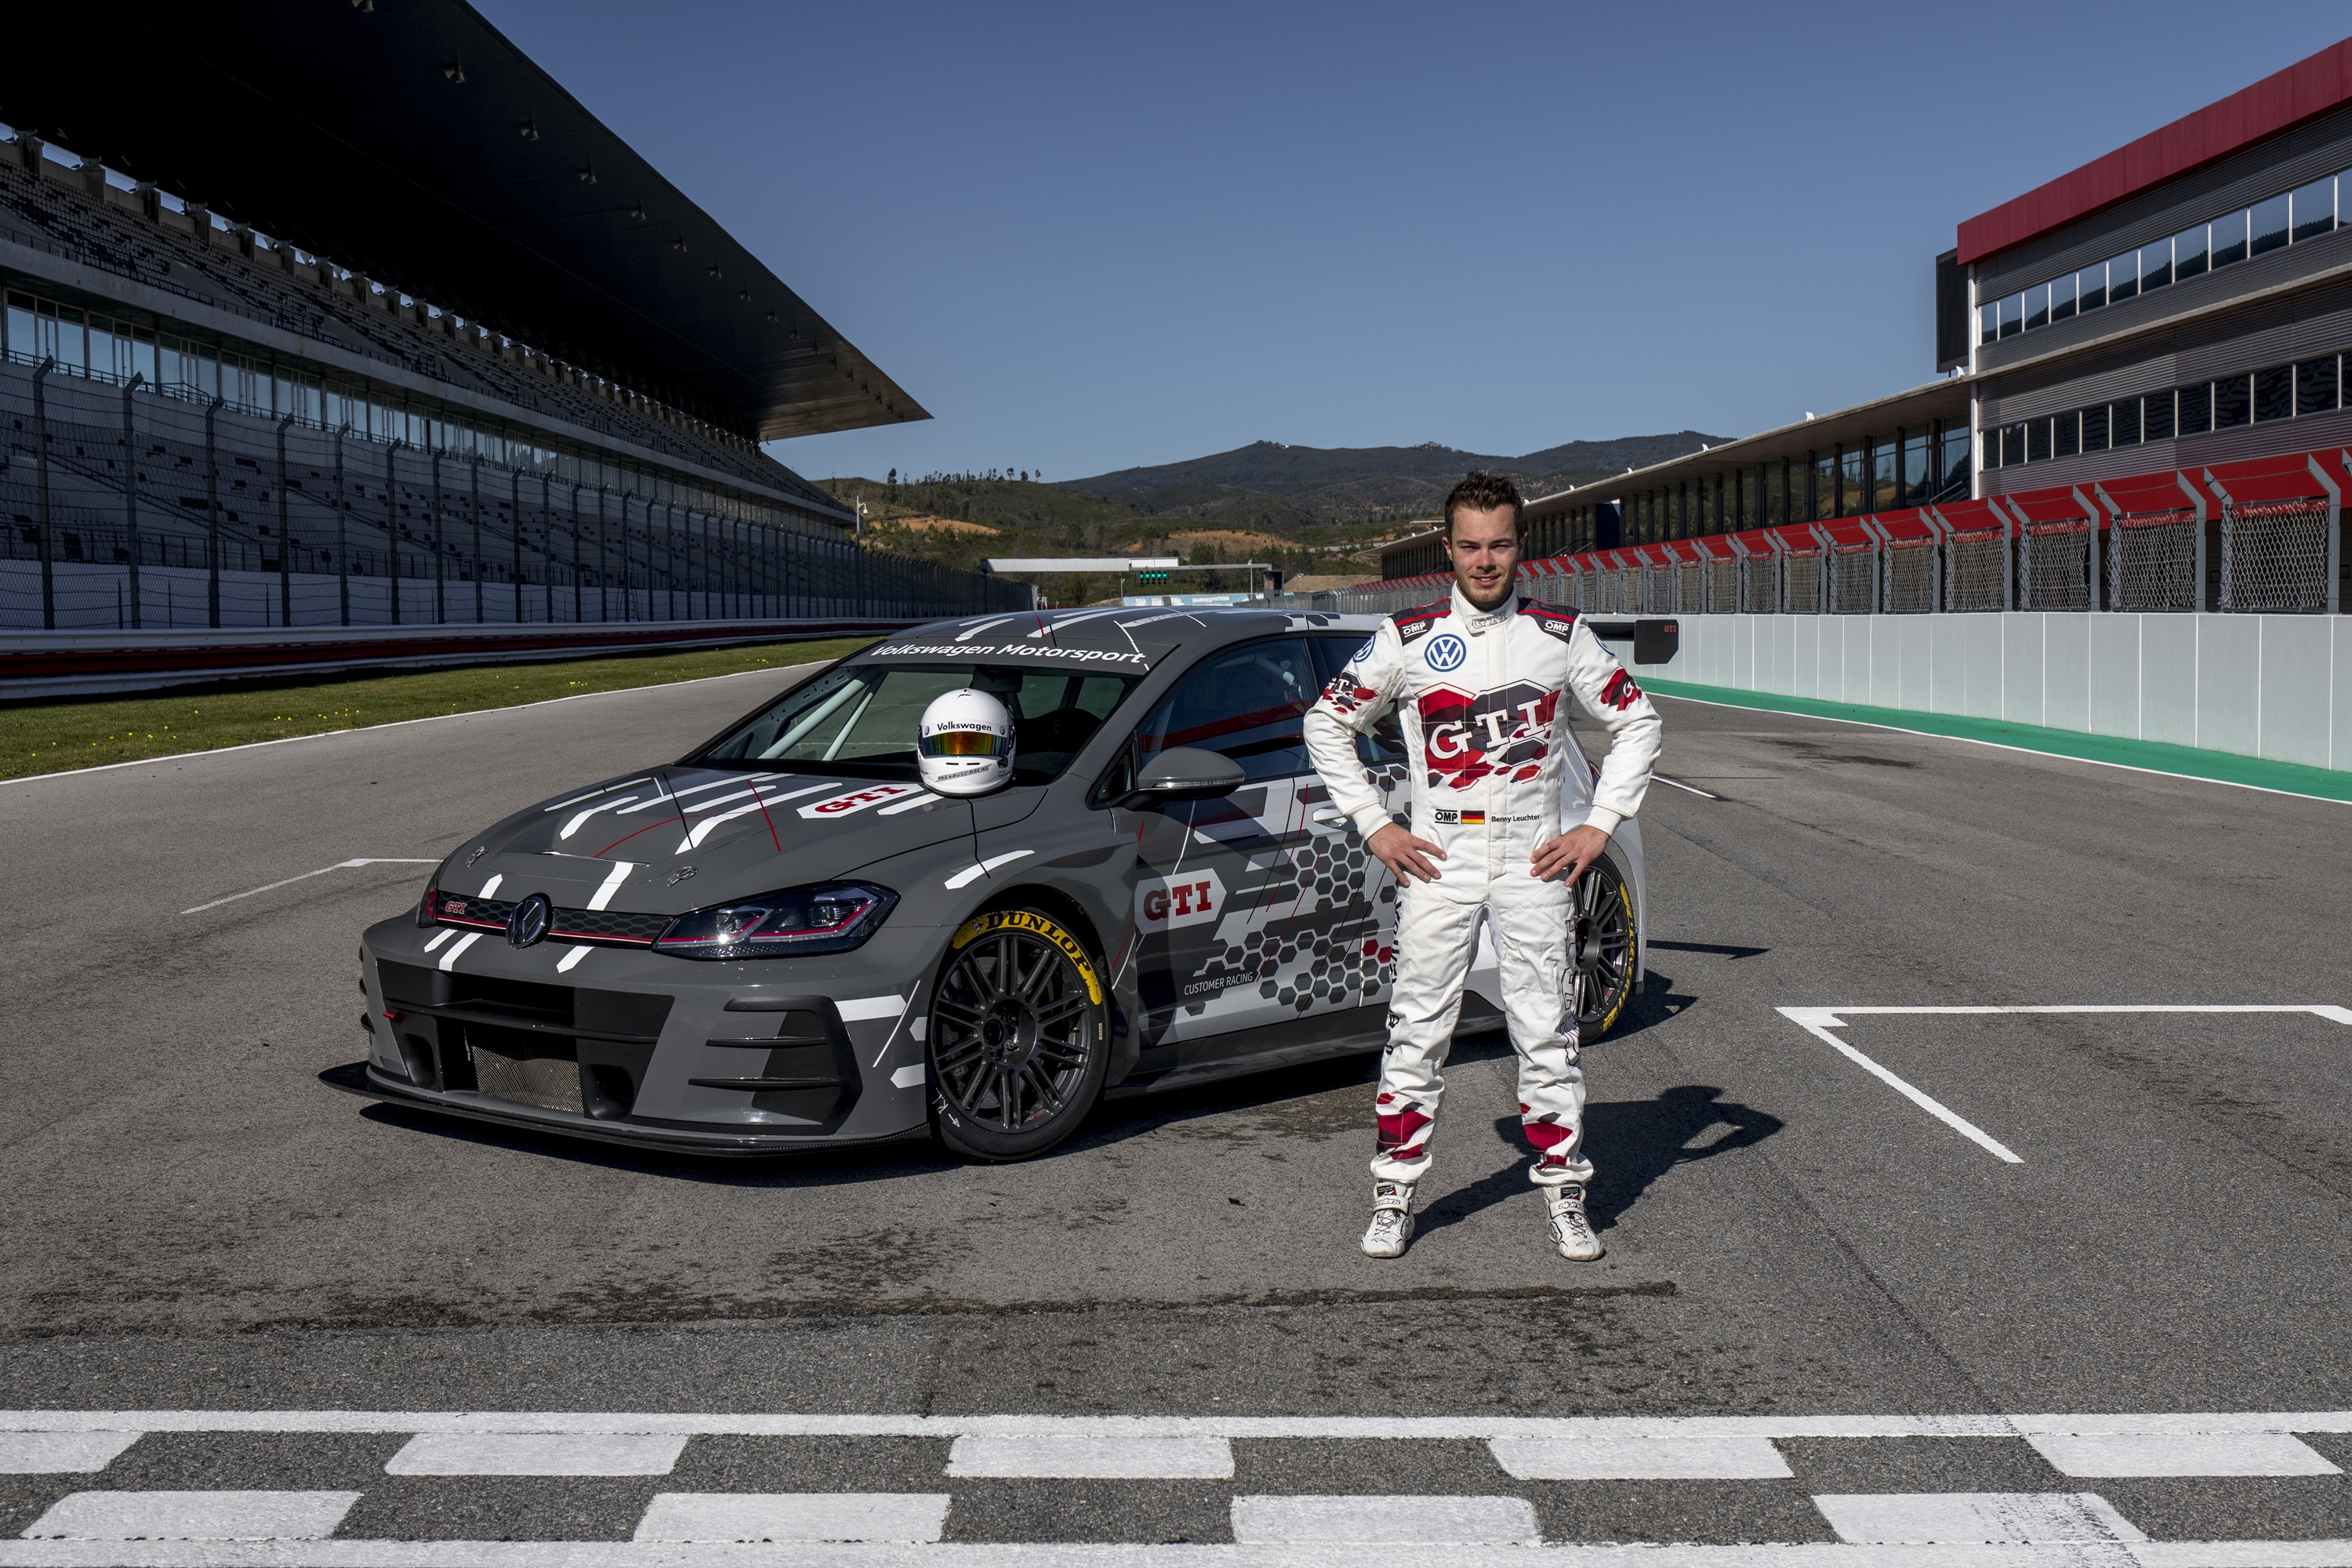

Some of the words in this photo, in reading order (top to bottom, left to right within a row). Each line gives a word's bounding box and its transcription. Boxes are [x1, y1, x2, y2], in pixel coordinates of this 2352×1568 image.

[1403, 621, 1426, 635] OMP
[1472, 610, 1507, 629] GTI
[1545, 621, 1569, 633] OMP
[871, 644, 996, 656] Volkswagen
[996, 644, 1146, 663] Motorsport
[937, 721, 992, 731] Volkswagen
[1428, 699, 1547, 760] GTI
[815, 786, 909, 813] GTI
[1435, 811, 1458, 822] OMP
[445, 901, 467, 914] GTI
[1142, 880, 1212, 921] GTI
[985, 910, 1093, 973] DUNLOP
[1184, 978, 1225, 995] CUSTOMER
[1226, 971, 1253, 986] RACING
